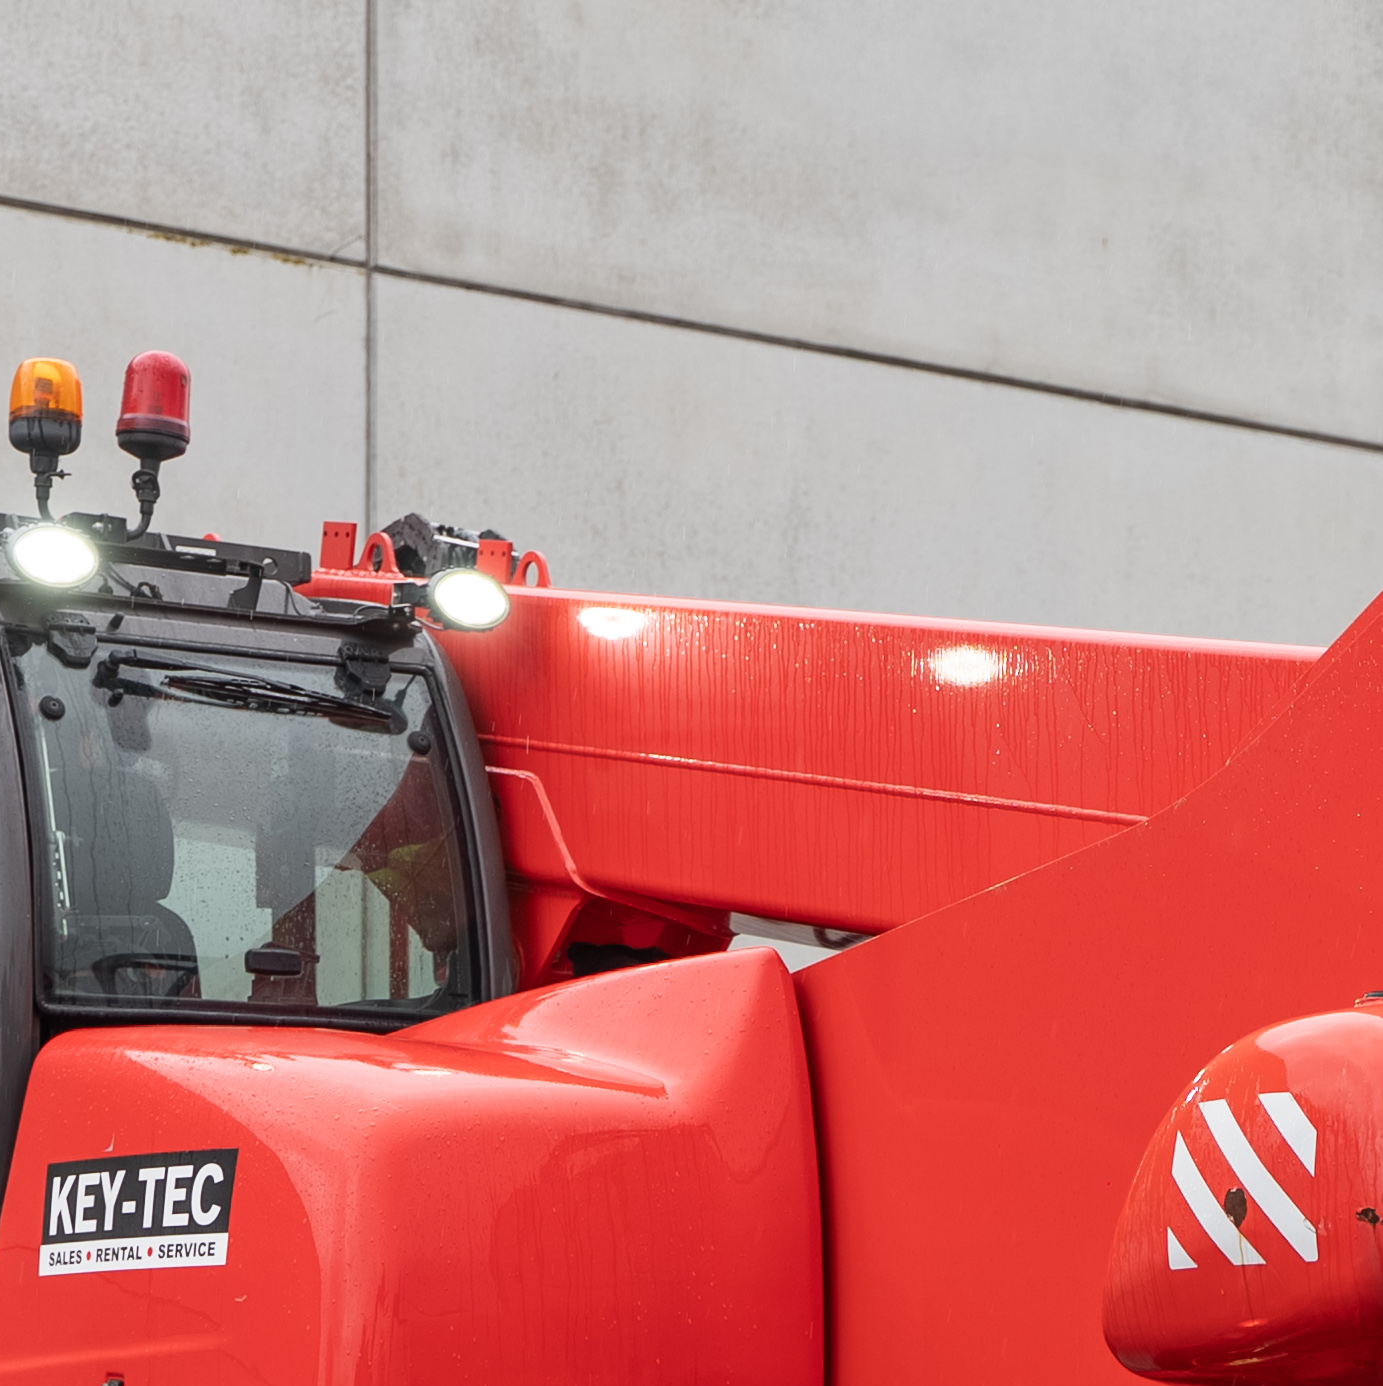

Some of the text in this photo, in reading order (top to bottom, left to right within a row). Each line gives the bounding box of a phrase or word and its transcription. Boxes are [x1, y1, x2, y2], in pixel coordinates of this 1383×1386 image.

[49, 1163, 224, 1236] KEY-TEC
[48, 1242, 216, 1266] SALES RENTAL SERVICE
